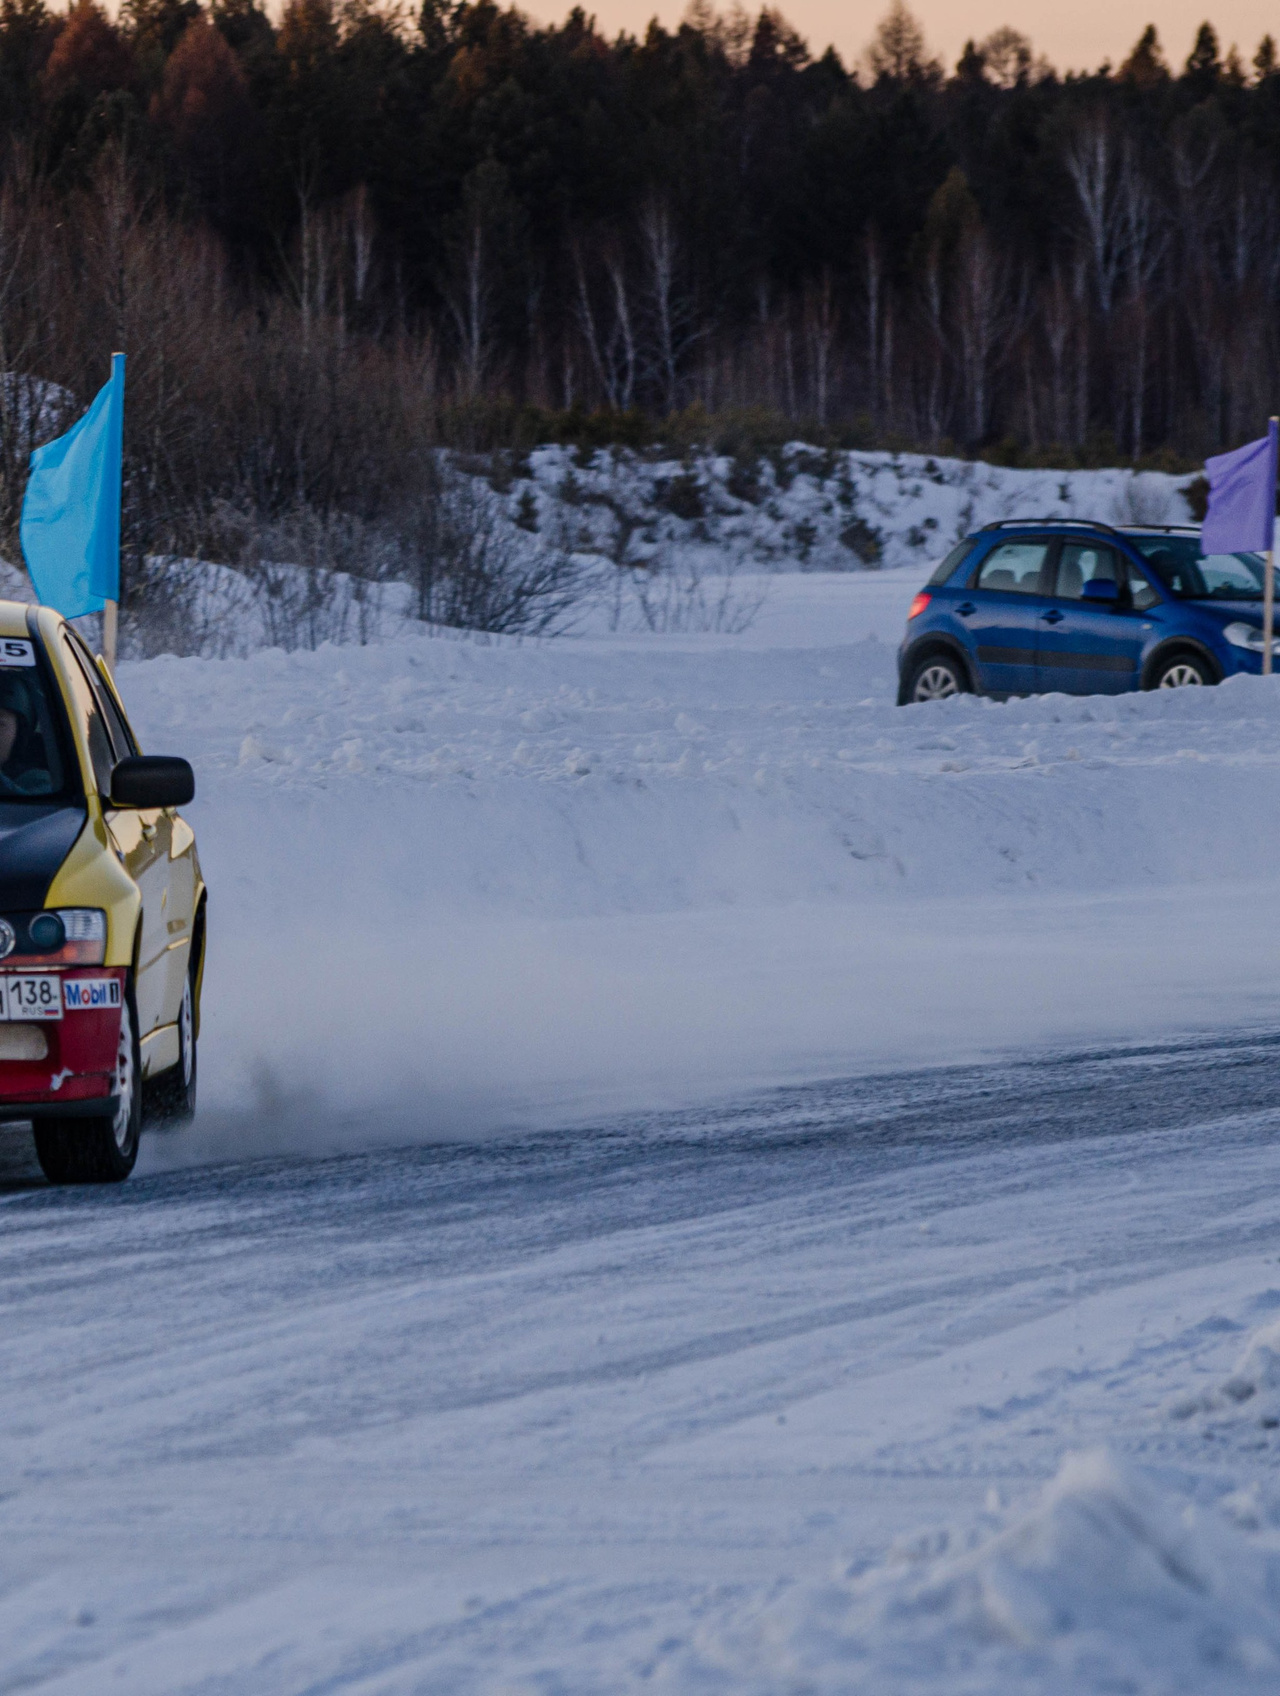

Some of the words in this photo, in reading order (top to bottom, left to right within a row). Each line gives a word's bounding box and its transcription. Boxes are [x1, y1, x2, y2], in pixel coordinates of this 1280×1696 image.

[9, 980, 52, 1006] 138
[65, 983, 106, 1005] Mobil
[21, 1007, 44, 1017] RUS
